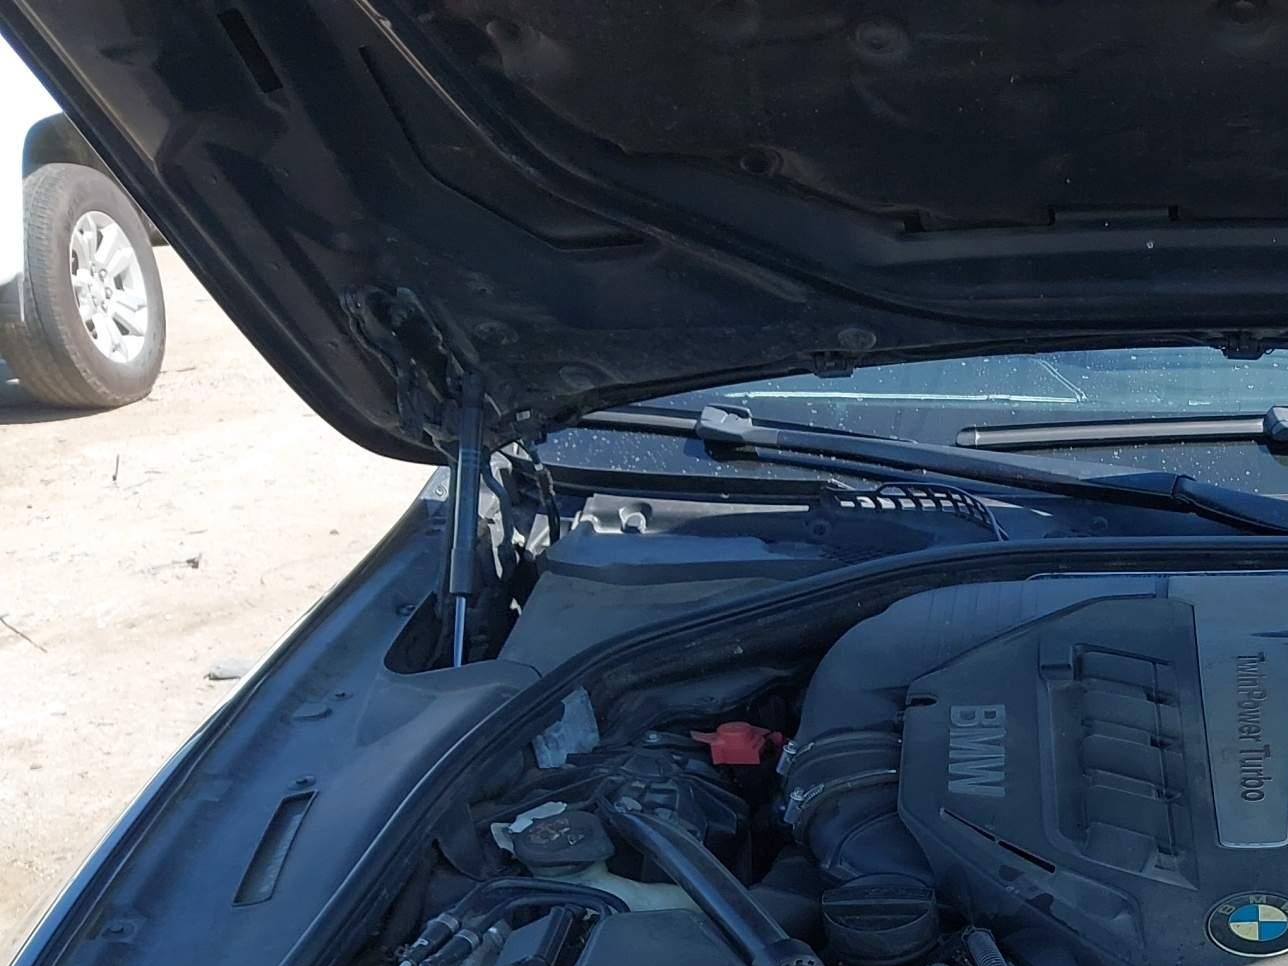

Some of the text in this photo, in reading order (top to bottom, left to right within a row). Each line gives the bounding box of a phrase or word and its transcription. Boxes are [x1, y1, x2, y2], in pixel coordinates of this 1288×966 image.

[948, 704, 1007, 797] BMW
[1236, 652, 1273, 802] TwinPower Turbo
